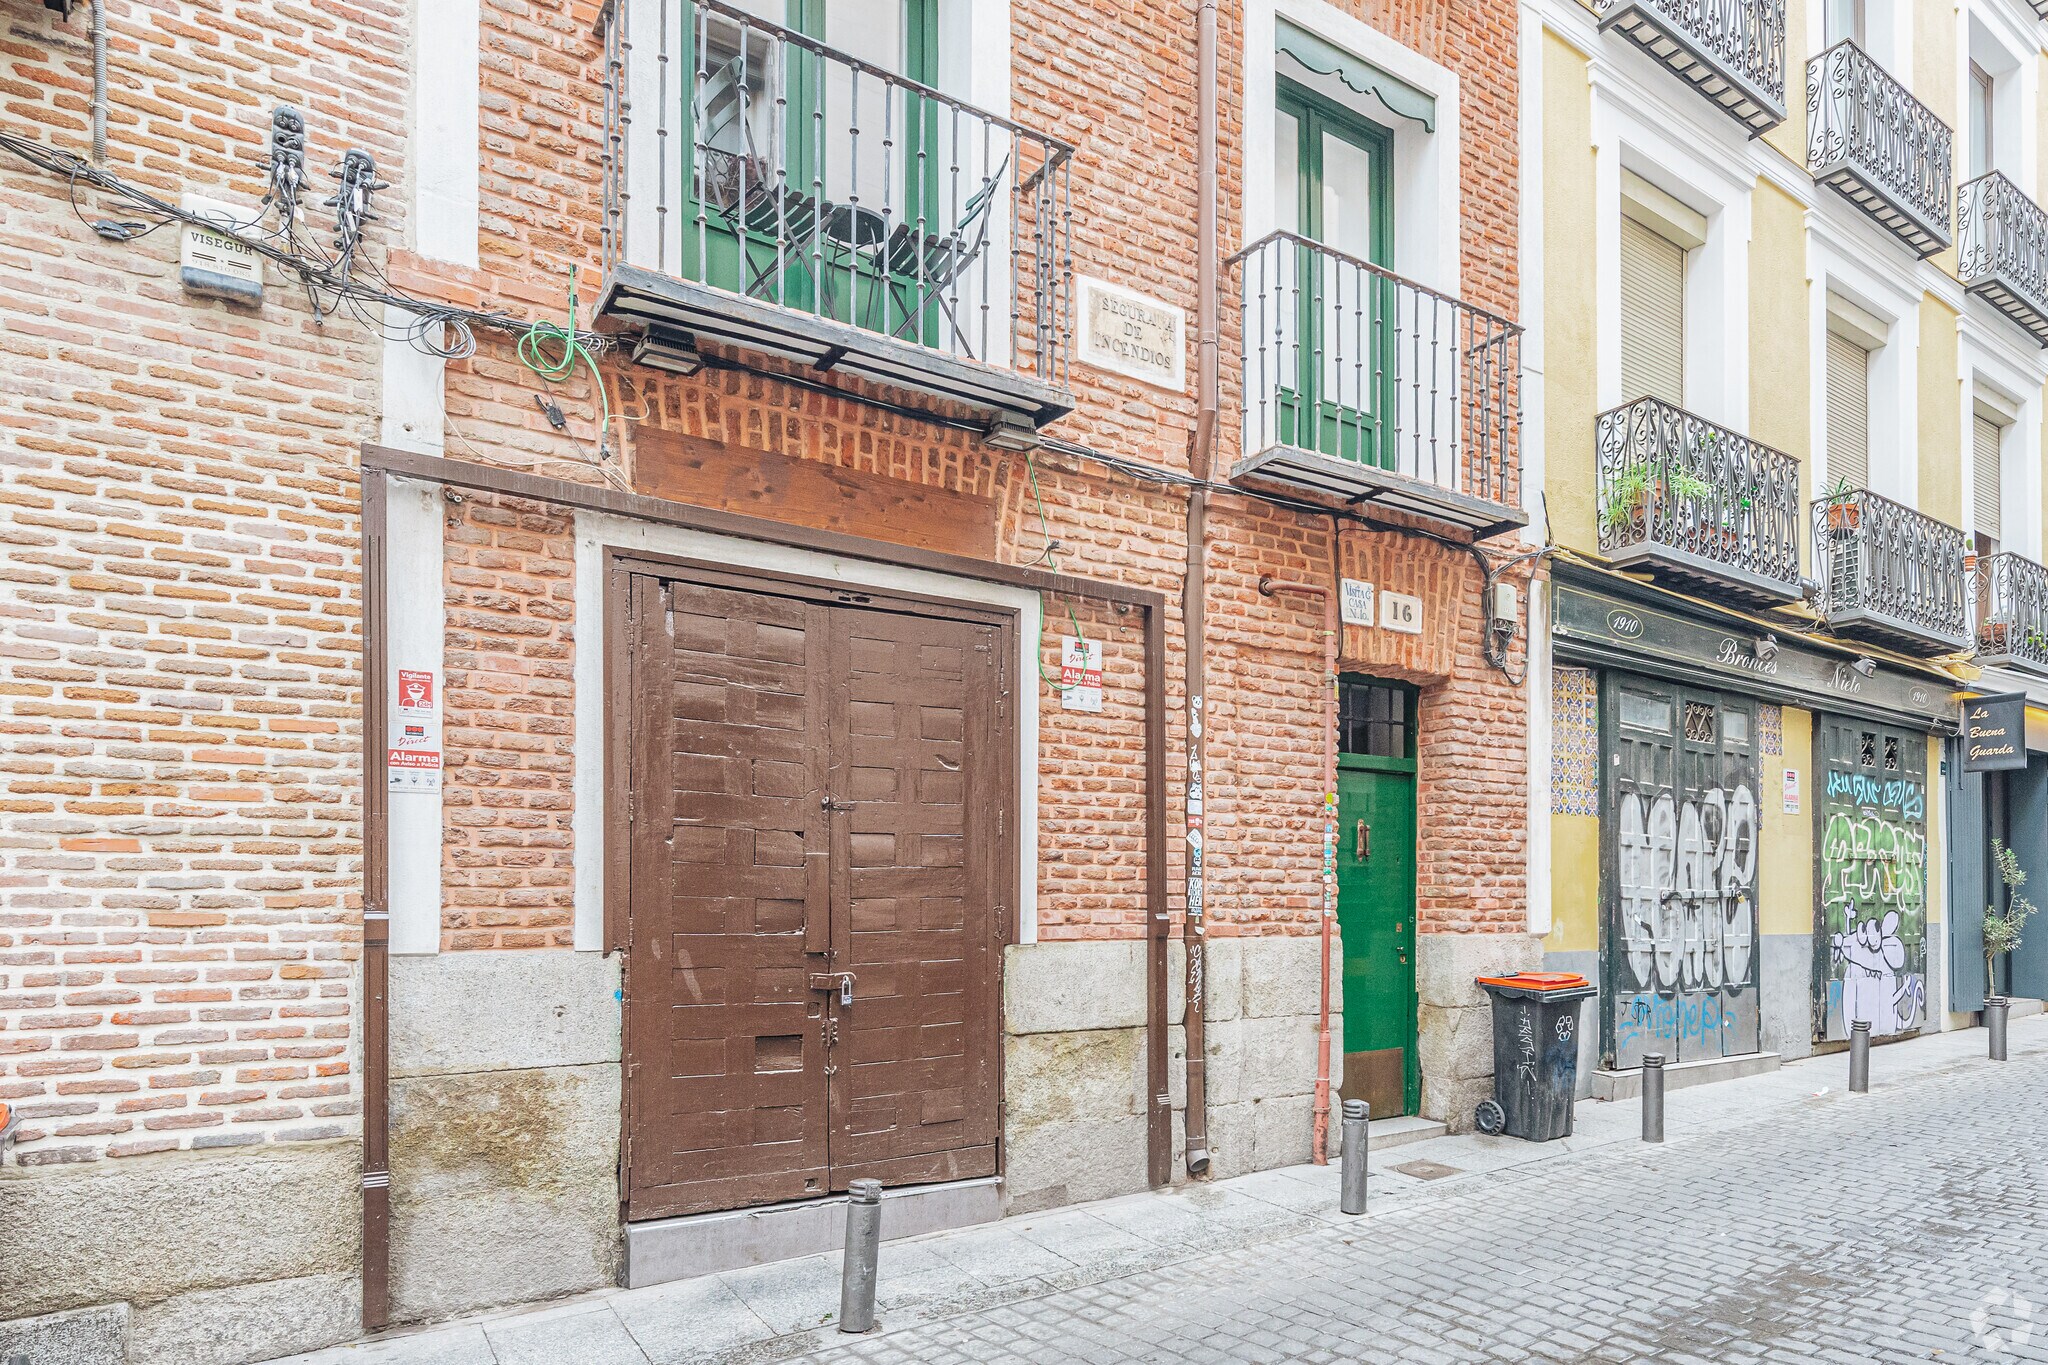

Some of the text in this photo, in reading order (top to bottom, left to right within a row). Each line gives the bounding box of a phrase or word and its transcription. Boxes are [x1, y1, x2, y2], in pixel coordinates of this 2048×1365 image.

[191, 232, 253, 256] VISEGUR
[1124, 321, 1142, 340] DE
[1095, 331, 1171, 369] INCENDIOS
[1349, 597, 1367, 609] CASA
[1392, 601, 1412, 622] 16
[1612, 616, 1638, 633] 1910
[1827, 667, 1861, 694] Nieto
[1912, 690, 1927, 704] 1910
[1970, 707, 1989, 720] La
[1969, 726, 2006, 739] Buena
[390, 751, 439, 763] Alarma
[1969, 743, 2015, 761] Guarda
